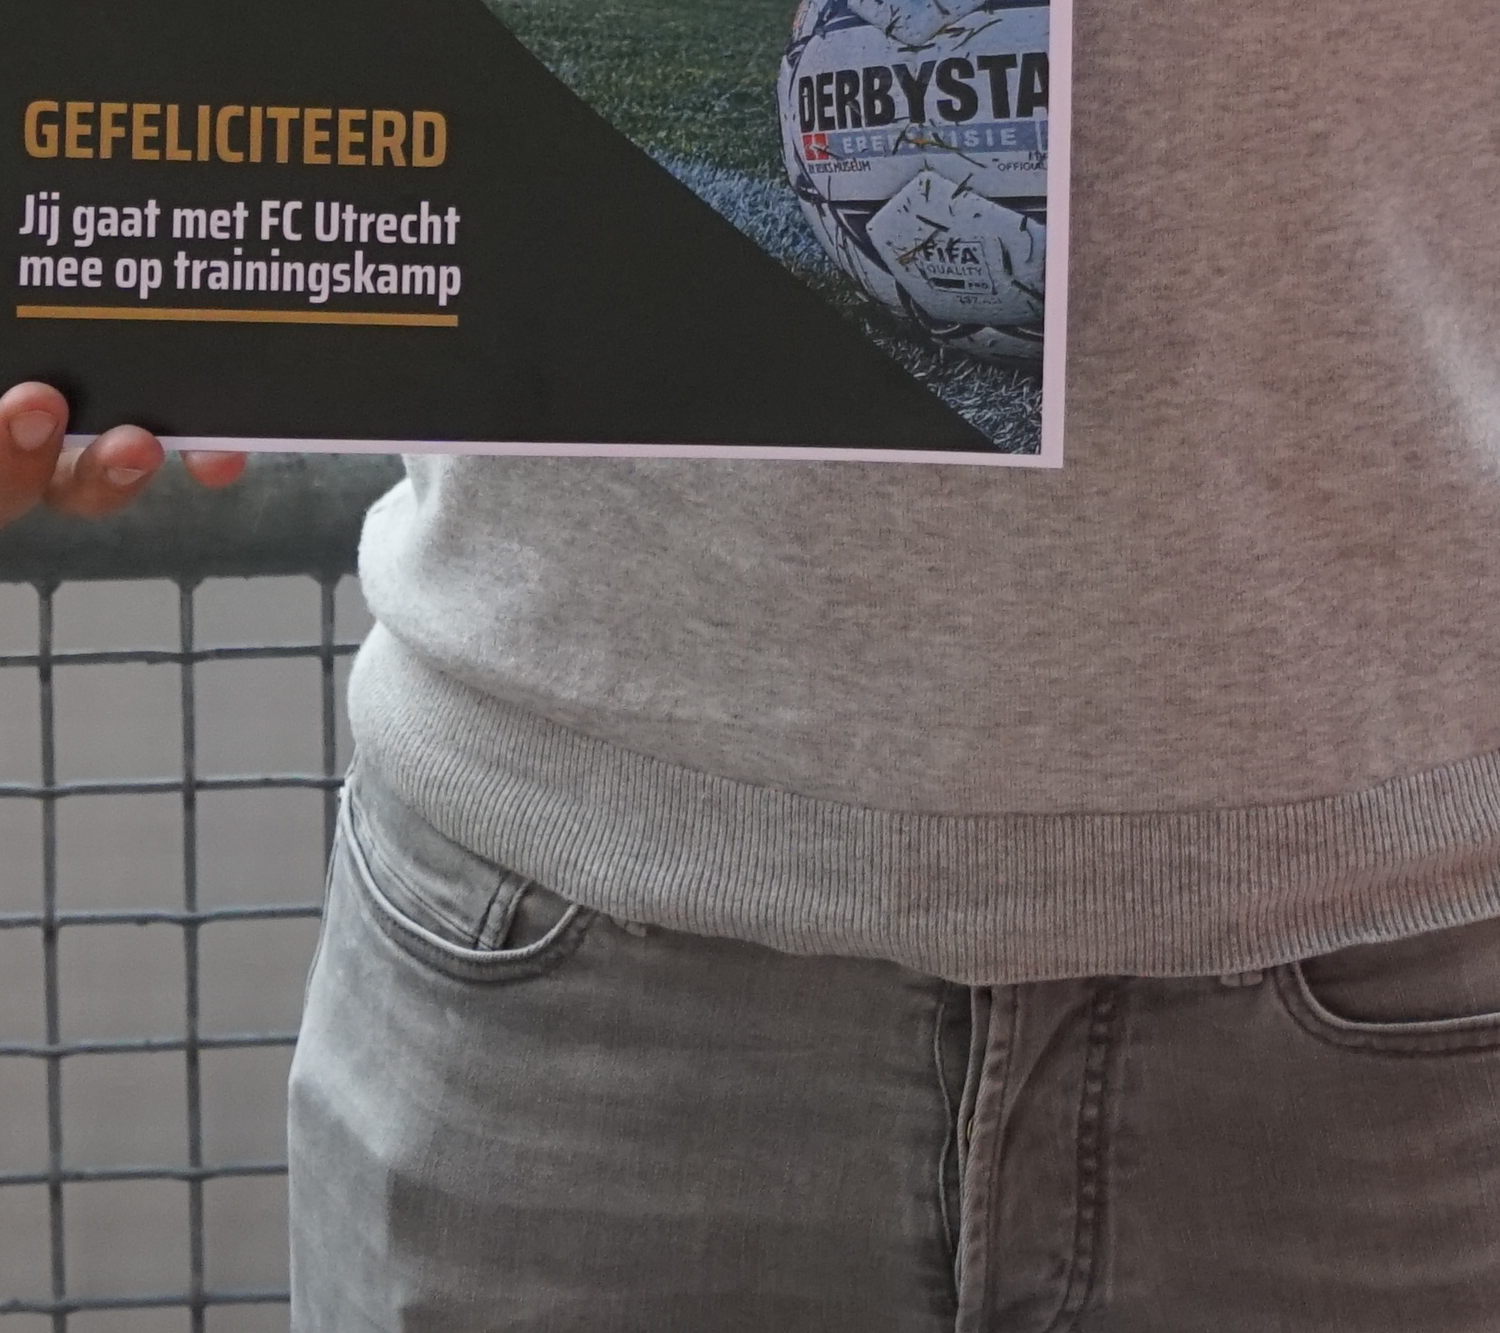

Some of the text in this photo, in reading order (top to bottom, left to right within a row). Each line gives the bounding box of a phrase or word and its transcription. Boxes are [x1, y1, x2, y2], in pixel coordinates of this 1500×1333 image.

[800, 52, 1049, 133] DERBYSTA
[24, 101, 447, 168] GEFELICITEERD
[842, 127, 1018, 155] EREISIE
[19, 192, 461, 248] Jij gaat met FC Utrecht
[19, 248, 462, 307] mee op trainingskamp
[922, 238, 980, 264] FIFA
[927, 264, 982, 276] QUALITY
